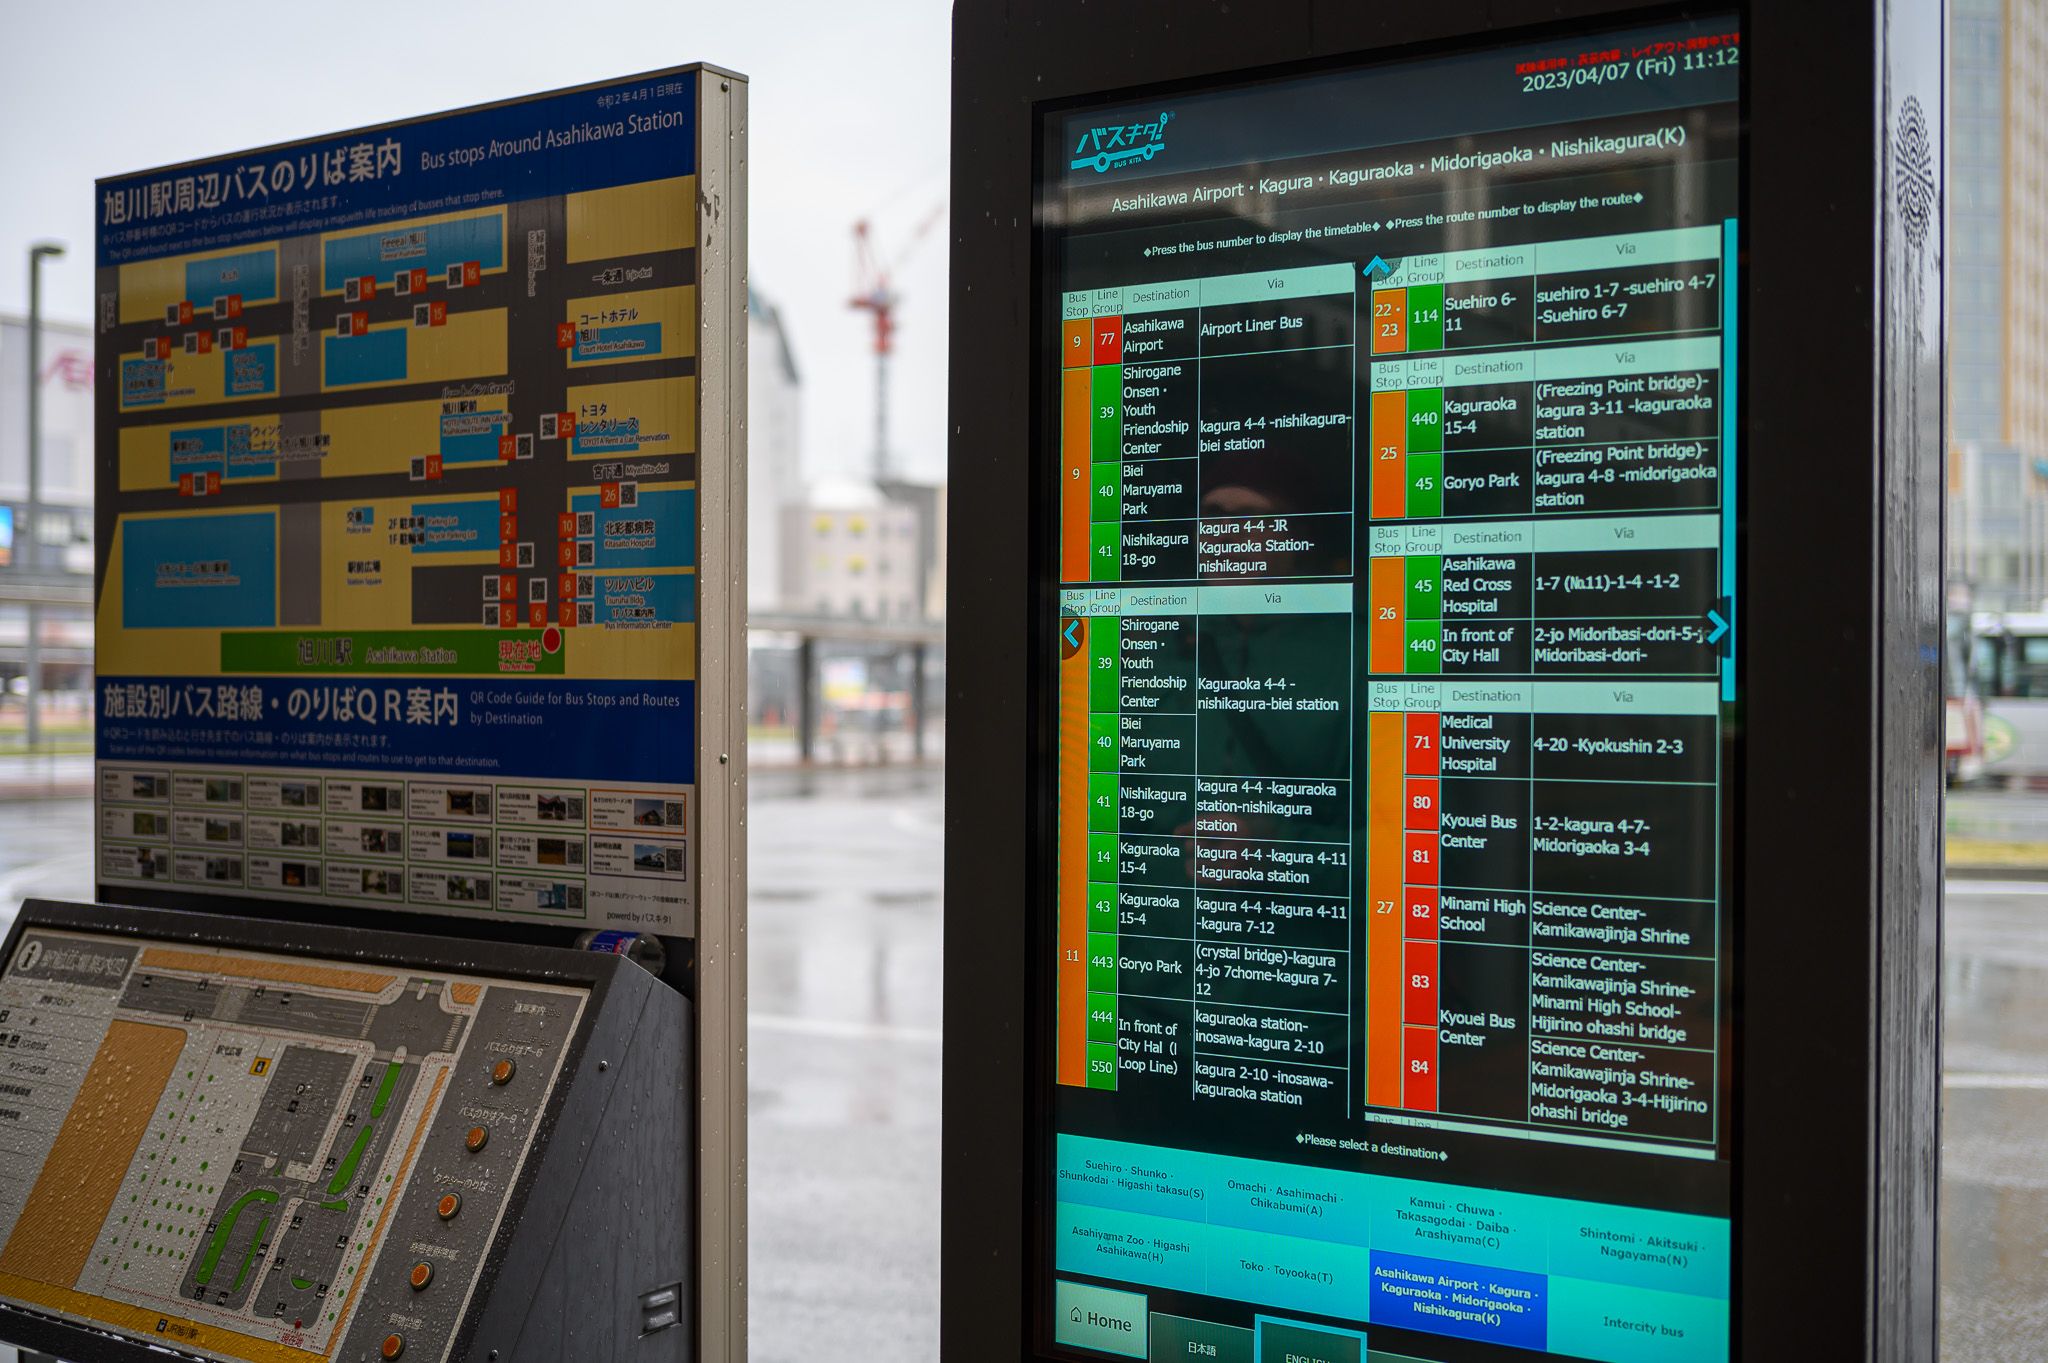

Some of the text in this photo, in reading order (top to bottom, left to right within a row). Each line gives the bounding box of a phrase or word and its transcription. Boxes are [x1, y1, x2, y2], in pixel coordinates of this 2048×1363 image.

[1522, 63, 1630, 92] 2023/04/07
[1636, 58, 1677, 80] (Fri)
[1683, 48, 1739, 70] 11:12
[597, 82, 683, 108] 令和2年4月1日現在
[421, 110, 683, 170] Bus stops Around Asahikawa Station
[1112, 126, 1687, 213] Asahikawa Airport Kagura Kaguraoka Midorigaoka Nishikagura(K)
[1114, 160, 1127, 168] BUS
[103, 137, 402, 226] 旭川駅周辺バスのりば案内
[1152, 222, 1372, 257] Press the bus number to display the timetable
[1267, 278, 1284, 290] Via
[1537, 274, 1716, 303] suehiro 1-7 -suehiro 4-7
[1092, 289, 1122, 316] Line Group
[1132, 288, 1190, 304] Destination
[1445, 294, 1517, 312] Suehiro 6-
[1066, 292, 1089, 318] Bus Stop
[580, 309, 638, 325] コートホテル
[1413, 309, 1438, 324] 114
[1537, 304, 1628, 324] -Suehiro 6-7
[1124, 318, 1184, 334] Asahikawa
[1201, 316, 1303, 338] Airport Liner Bus
[1446, 318, 1462, 332] 11
[561, 328, 572, 342] 24
[580, 328, 599, 342] 旭川
[1073, 336, 1081, 348] 9
[1100, 333, 1115, 345] 77
[580, 340, 645, 354] Court Hotel Asahikawa
[1124, 338, 1164, 354] Airport
[1124, 364, 1182, 380] Shirogane
[1123, 386, 1160, 398] Onsen
[580, 404, 608, 416] トヨタ
[1100, 406, 1114, 418] 39
[1123, 404, 1156, 418] Youth
[562, 418, 572, 432] 25
[580, 418, 638, 434] レンタリース
[1123, 420, 1189, 436] Friendoship
[1200, 412, 1352, 434] kagura 4-4 -nishikagura-
[502, 441, 513, 454] 27
[1123, 442, 1161, 455] Center
[1200, 438, 1265, 452] biei station
[593, 464, 624, 479] 宮下通
[605, 489, 616, 502] 26
[505, 522, 512, 534] 2
[562, 520, 572, 532] 10
[605, 520, 654, 535] 北彩都病院
[630, 538, 655, 549] Hospital
[505, 550, 512, 560] 3
[564, 548, 571, 560] 9
[504, 581, 512, 593] 4
[565, 580, 571, 592] 8
[605, 577, 654, 592] ツルハビル
[505, 610, 512, 622] 5
[535, 611, 542, 622] 6
[564, 610, 570, 621] 7
[616, 621, 650, 630] Information
[652, 621, 672, 629] Center
[297, 637, 458, 666] 旭川駅 Asahikawa Station
[500, 641, 540, 660] 現在地
[103, 683, 458, 727] 施設別バス路線・のりばQR案内
[470, 691, 680, 709] QR Code Guide for Bus Stops and Routes
[470, 711, 543, 725] by Destination
[1442, 715, 1493, 730] Medical
[1413, 735, 1432, 750] 71
[1442, 736, 1511, 753] University
[1534, 738, 1684, 756] 4-20 -Kyokushin 2-3
[1442, 756, 1497, 772] Hospital
[1412, 904, 1430, 918] 82
[1440, 896, 1526, 917] Minami High
[1532, 901, 1647, 921] Science Center-
[606, 910, 630, 922] powerd
[632, 912, 640, 922] by
[1440, 916, 1486, 932] School
[1532, 922, 1690, 945] Kamikawajinja Shrine
[1066, 950, 1080, 962] 11
[1092, 956, 1114, 968] 443
[1119, 957, 1182, 974] Goryo Park
[1304, 1133, 1439, 1160] Please select a destination
[1085, 1160, 1168, 1180] Suehiro Shunko
[1059, 1170, 1204, 1201] Shunkodai Higashi takasu(S)
[1228, 1180, 1338, 1204] Omachi Asahimachi
[1250, 1196, 1324, 1218] Chikabumi(A)
[1374, 1266, 1532, 1301] Asahikawa Airport Kagura
[1381, 1282, 1524, 1314] Kaguraoka Midorigaoka
[1086, 1311, 1133, 1332] Home
[1413, 1302, 1501, 1326] Nishikagura(K)
[1602, 1316, 1684, 1338] Intercity bus
[1187, 1342, 1217, 1358] 日本語
